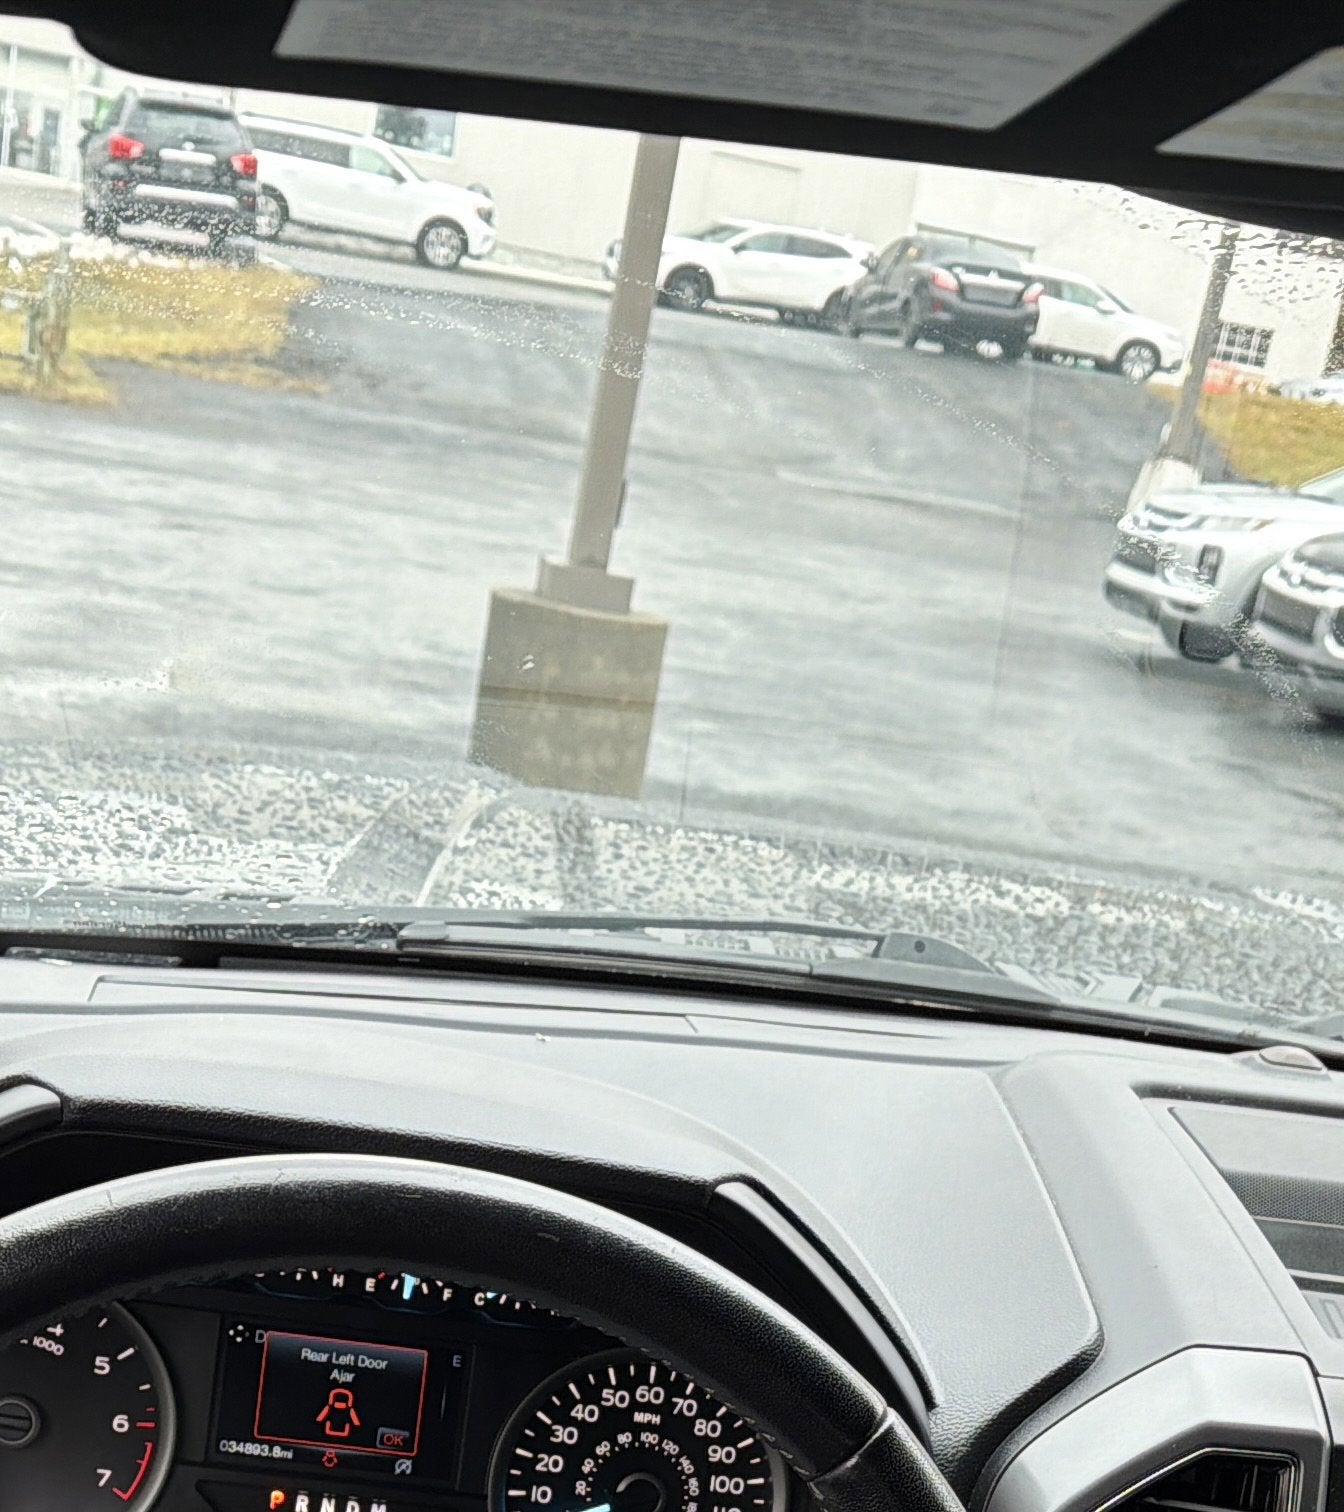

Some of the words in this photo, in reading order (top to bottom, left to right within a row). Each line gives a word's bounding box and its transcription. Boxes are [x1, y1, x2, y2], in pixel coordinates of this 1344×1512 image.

[332, 1274, 344, 1287] H
[365, 1278, 376, 1292] E
[443, 1288, 453, 1301] F
[474, 1292, 485, 1306] C
[33, 1336, 65, 1356] 1000
[93, 1356, 110, 1375] 5
[301, 1348, 330, 1363] Rear
[332, 1351, 356, 1367] Left
[357, 1355, 388, 1371] Door
[329, 1368, 355, 1384] Ajar
[601, 1388, 630, 1409] 50
[635, 1385, 665, 1405] 60
[570, 1403, 600, 1423] 40
[671, 1396, 698, 1418] 70
[112, 1414, 129, 1433] 6
[633, 1411, 662, 1426] MPH
[693, 1418, 723, 1438] 80
[382, 1432, 405, 1447] OK
[550, 1425, 579, 1445] 30
[617, 1431, 633, 1445] 80
[640, 1431, 659, 1445] 100
[661, 1438, 680, 1456] 120
[707, 1445, 737, 1464] 90
[535, 1453, 564, 1473] 20
[678, 1455, 695, 1475] 140
[96, 1467, 112, 1488] 7
[709, 1474, 745, 1495] 100
[269, 1489, 285, 1511] P
[531, 1485, 553, 1504] 10
